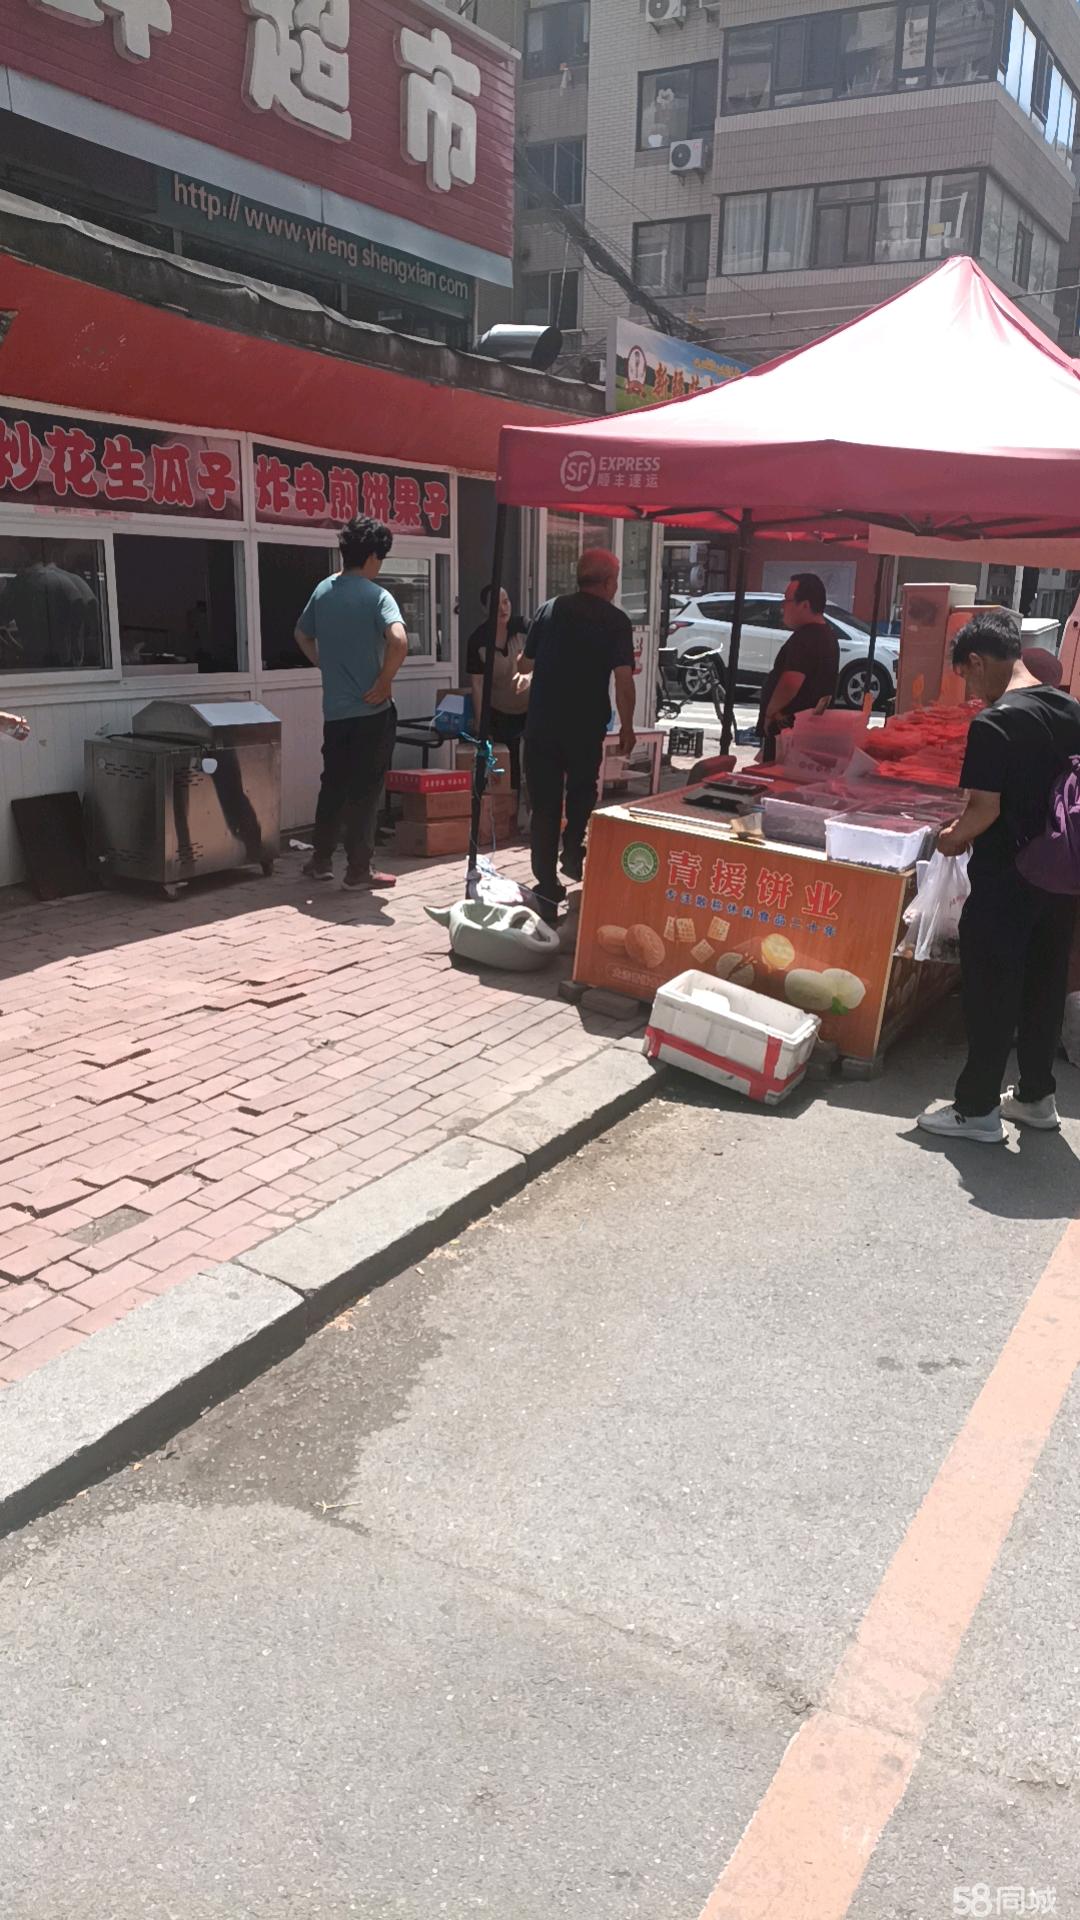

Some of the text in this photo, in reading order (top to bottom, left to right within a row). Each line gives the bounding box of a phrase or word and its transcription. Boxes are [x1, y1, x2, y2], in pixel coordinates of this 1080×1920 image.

[362, 241, 436, 289] shengxian
[597, 473, 659, 488] 顺丰速运
[598, 456, 661, 472] EXPRESS
[256, 454, 448, 531] 炸串煎饼果子
[668, 850, 842, 920] 青援饼业
